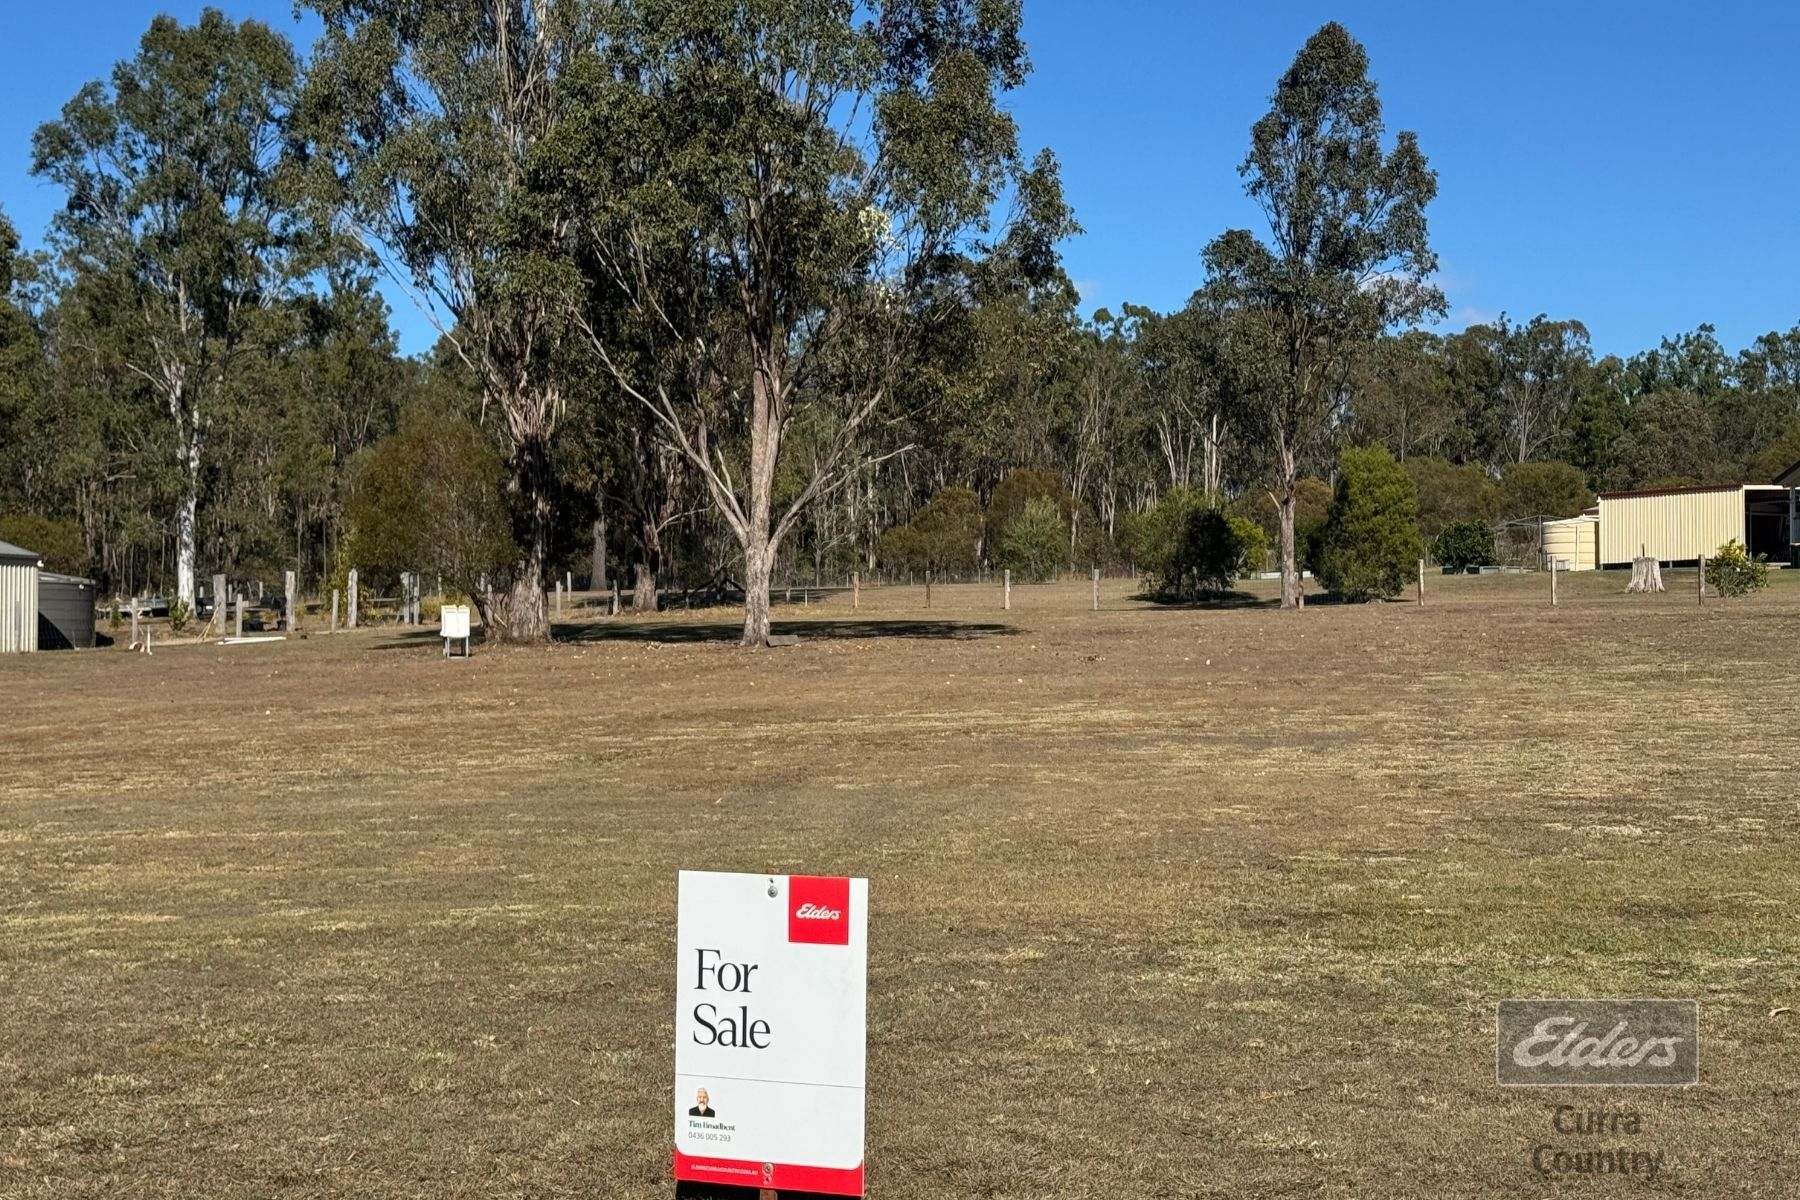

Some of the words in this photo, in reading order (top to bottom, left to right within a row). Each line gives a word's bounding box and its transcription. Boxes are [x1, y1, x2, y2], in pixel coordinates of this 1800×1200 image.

[796, 903, 841, 920] Elders
[693, 948, 758, 993] For
[693, 1003, 771, 1049] Sale
